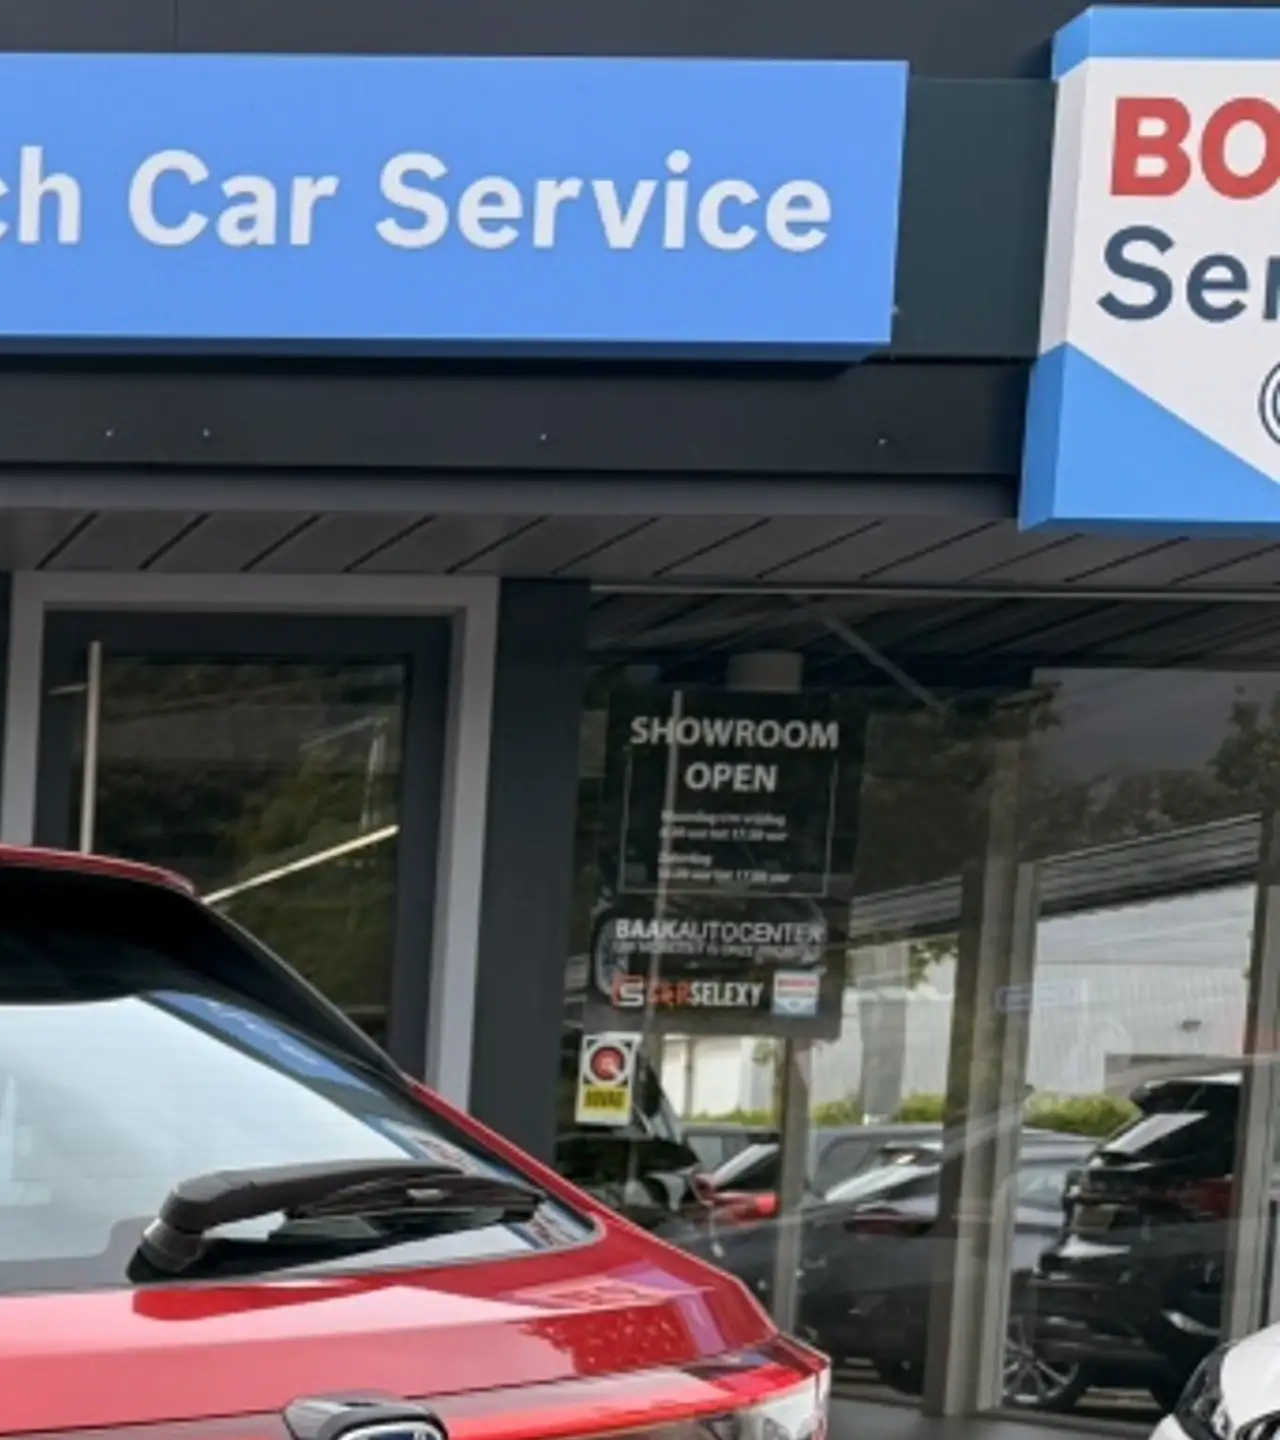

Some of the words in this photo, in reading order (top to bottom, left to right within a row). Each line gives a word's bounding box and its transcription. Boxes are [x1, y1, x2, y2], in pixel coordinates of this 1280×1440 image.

[1110, 97, 1280, 200] BO
[128, 149, 339, 247] Car
[375, 150, 832, 252] Service
[630, 716, 839, 750] SHOWROOM
[685, 761, 778, 792] OPEN
